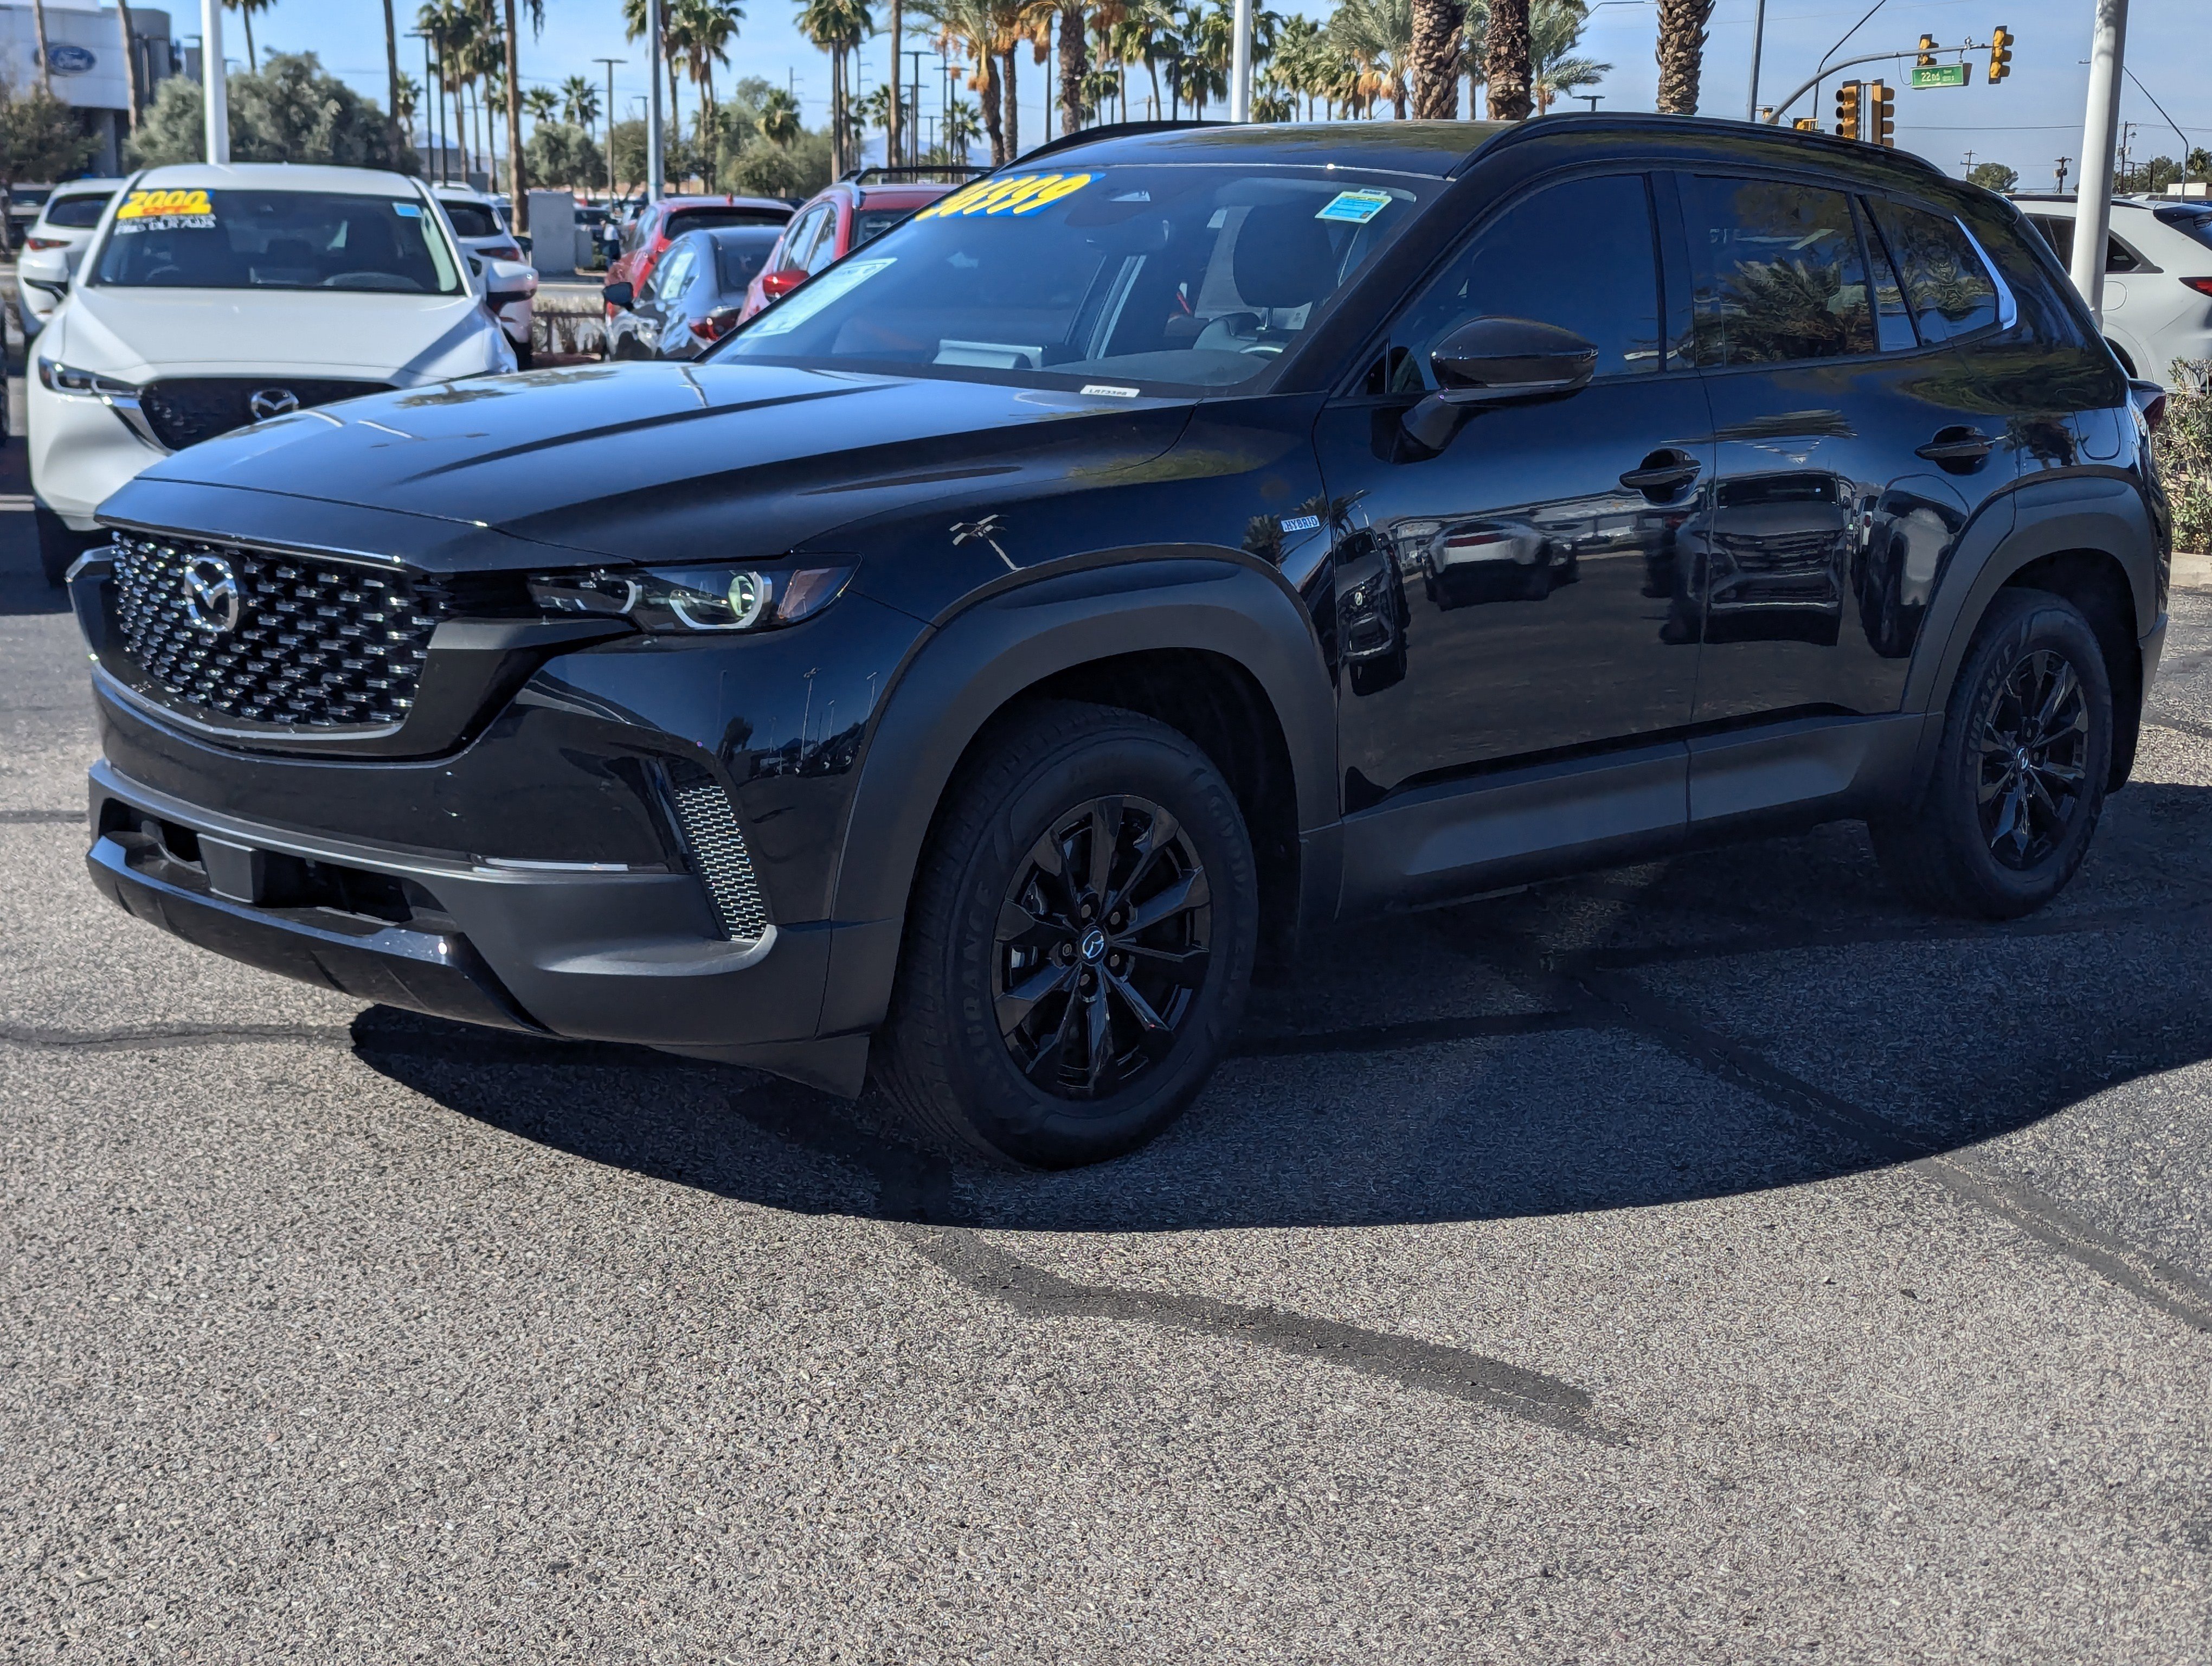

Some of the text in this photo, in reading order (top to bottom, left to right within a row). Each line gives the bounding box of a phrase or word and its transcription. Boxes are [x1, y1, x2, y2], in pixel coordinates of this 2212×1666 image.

[1921, 71, 1940, 82] 22nd
[118, 191, 212, 219] 2000
[1284, 516, 1318, 531] HYBRID
